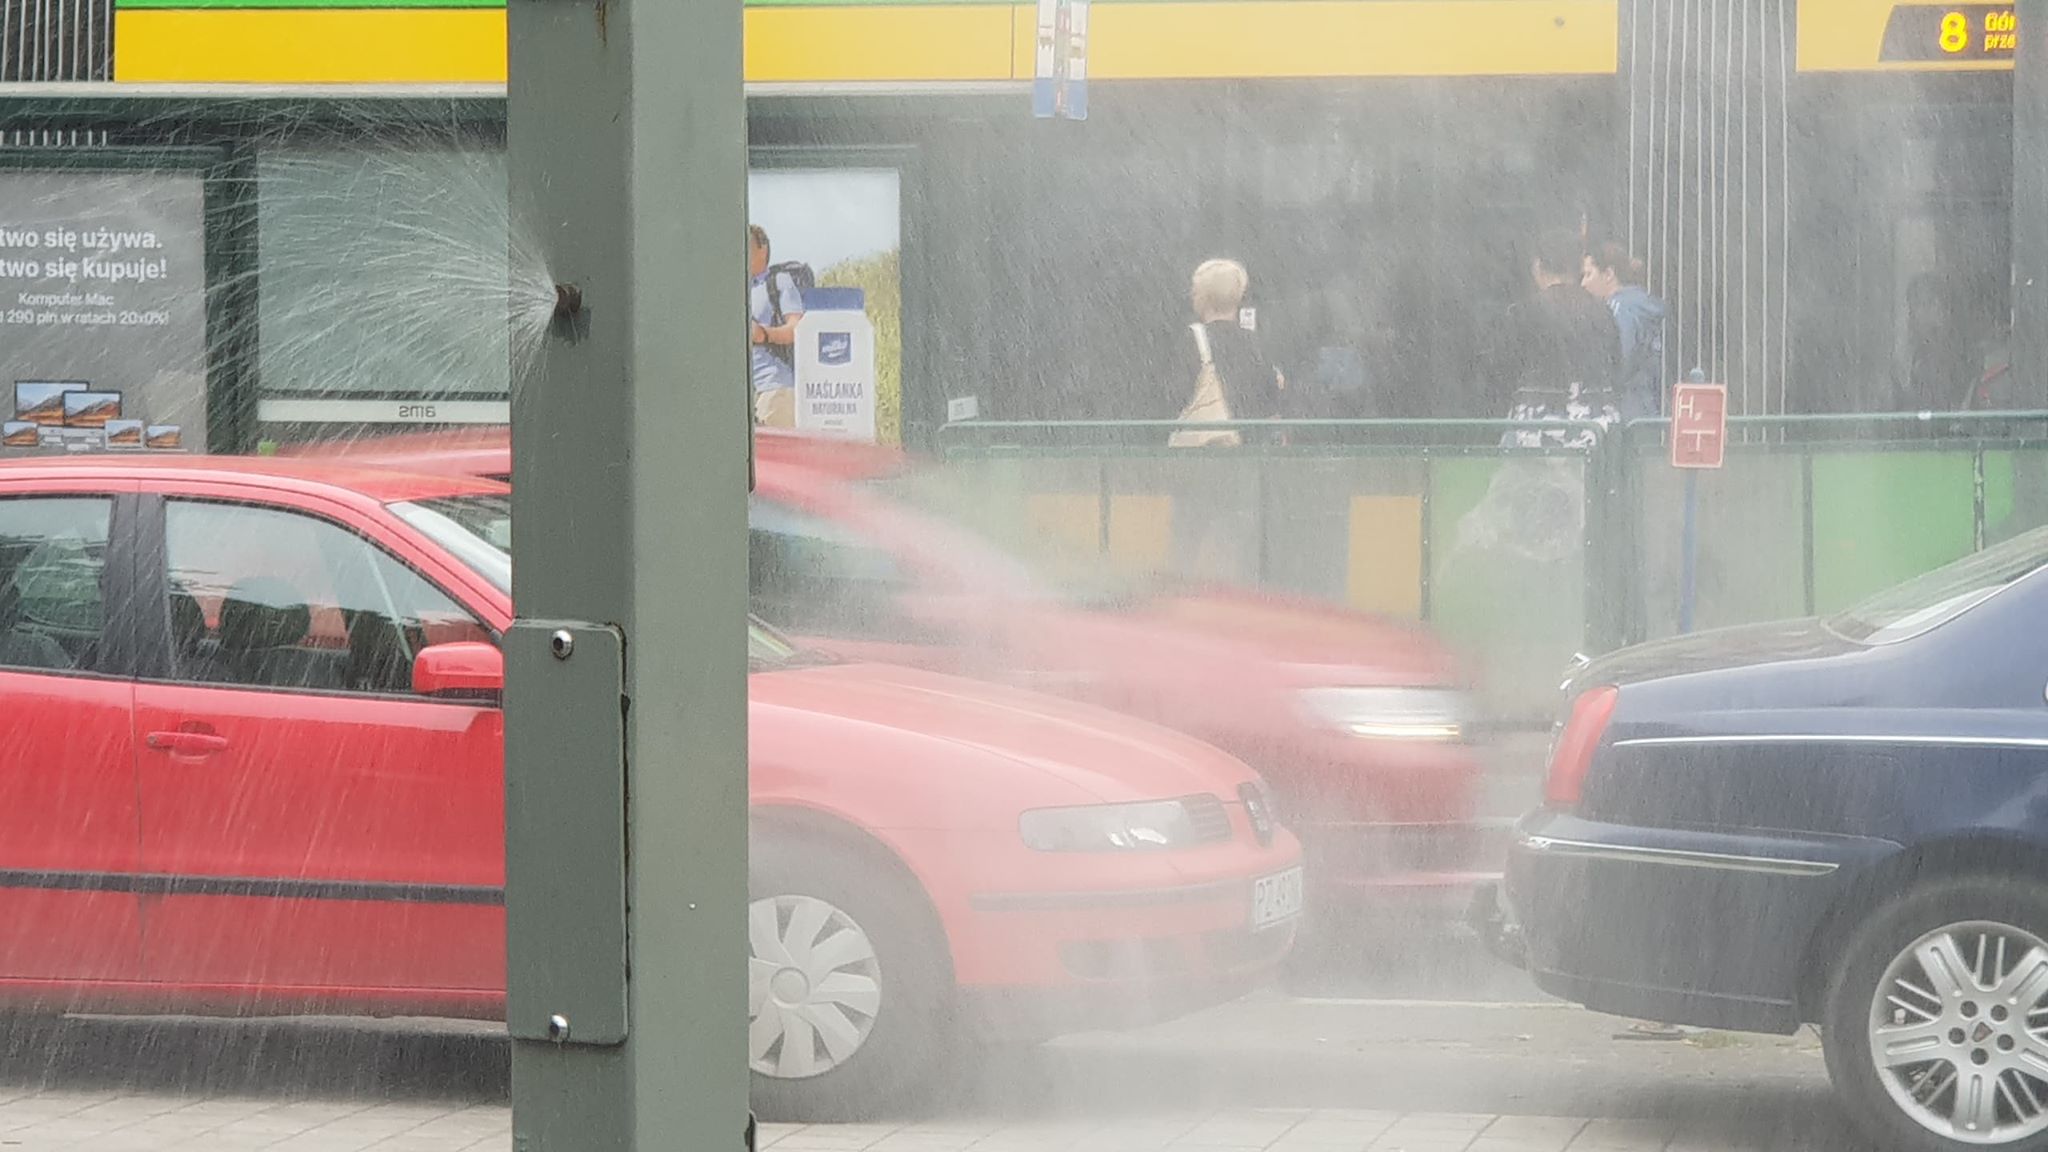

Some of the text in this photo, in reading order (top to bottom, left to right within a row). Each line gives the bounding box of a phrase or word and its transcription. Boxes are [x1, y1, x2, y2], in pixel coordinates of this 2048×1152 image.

[1939, 12, 1968, 52] 8
[44, 226, 77, 253] się
[82, 226, 163, 253] używa.
[45, 256, 78, 283] się
[83, 256, 167, 283] kupuje!
[18, 292, 115, 308] Komputer Mac
[7, 309, 34, 324] 290
[36, 311, 58, 326] pln
[60, 313, 72, 324] w
[73, 310, 117, 325] ratach
[806, 380, 863, 400] MAŚLANKA
